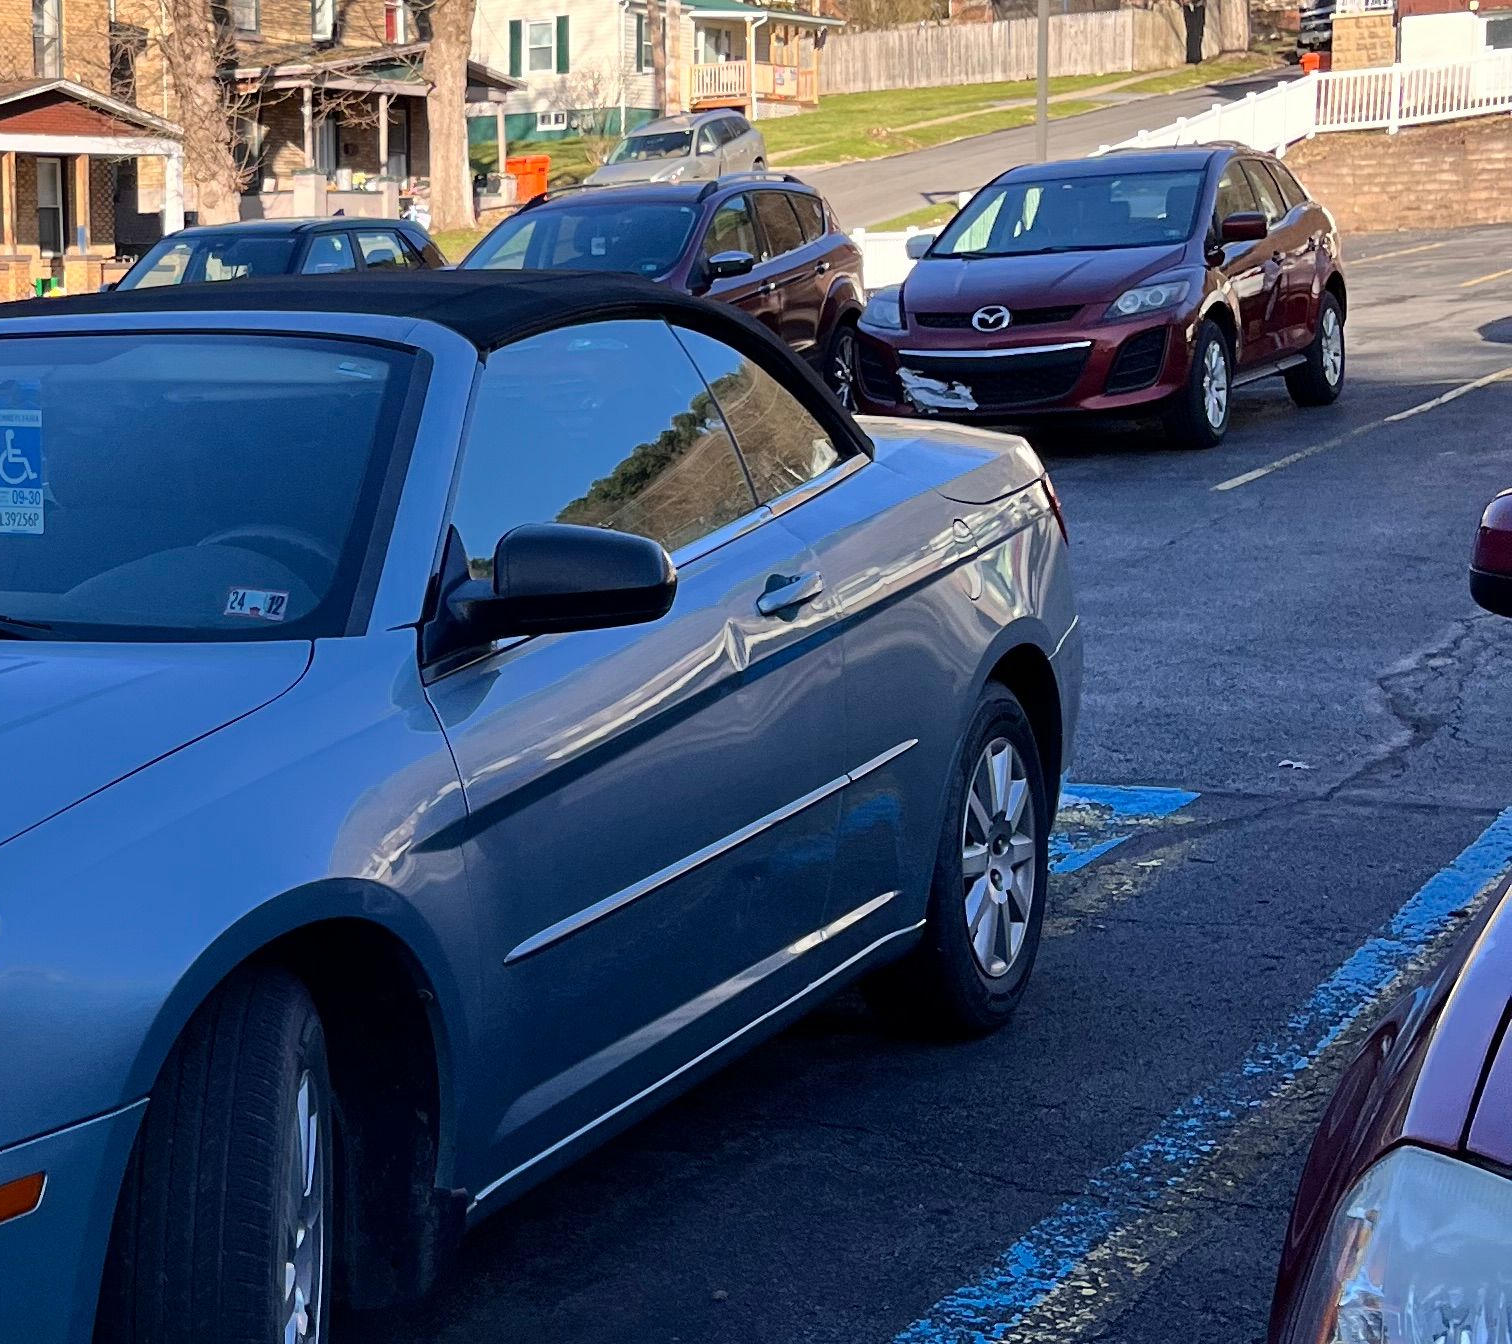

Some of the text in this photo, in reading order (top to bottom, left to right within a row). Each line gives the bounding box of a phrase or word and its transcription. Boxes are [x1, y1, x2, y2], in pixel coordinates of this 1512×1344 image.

[12, 490, 41, 505] 09-30
[0, 511, 39, 527] L39256P
[230, 591, 285, 615] 24 12
